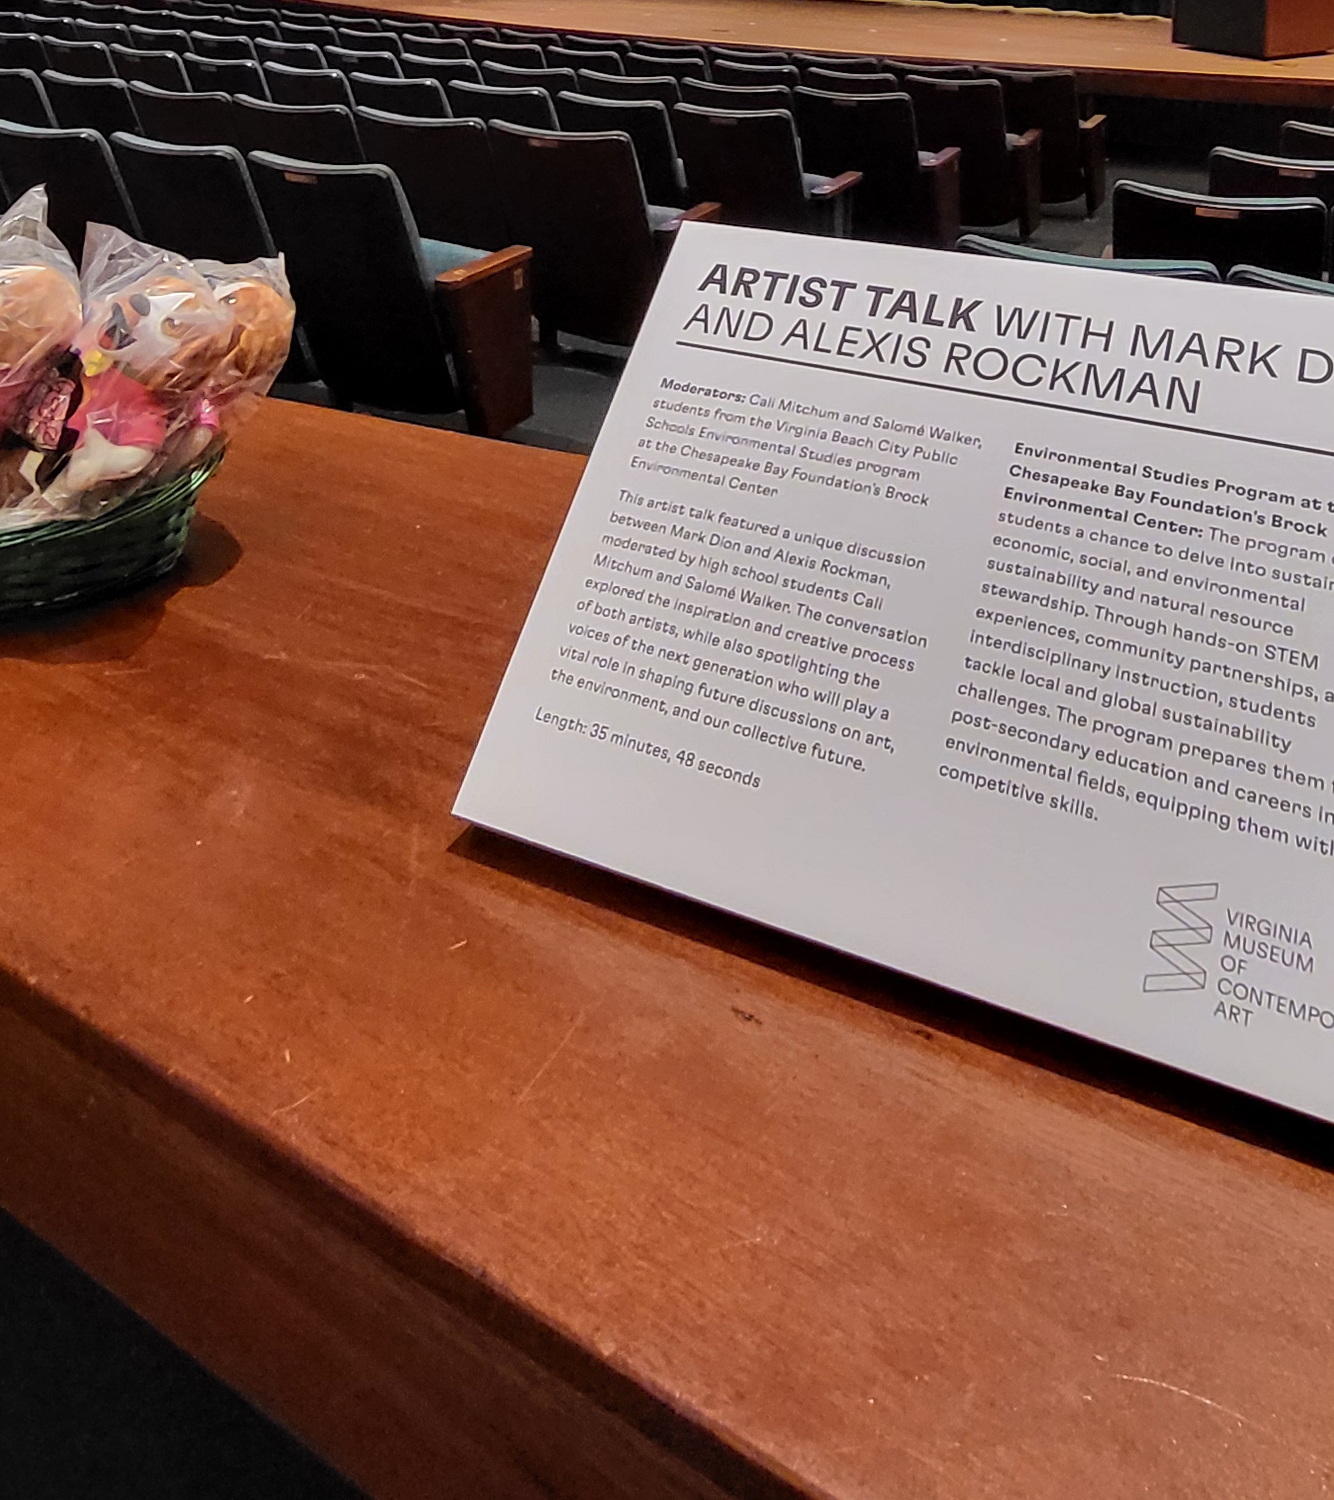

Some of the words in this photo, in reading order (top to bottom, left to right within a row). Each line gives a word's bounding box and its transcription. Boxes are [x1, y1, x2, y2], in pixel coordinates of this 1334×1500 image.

[682, 303, 774, 342] AND
[780, 318, 932, 369] ALEXIS
[943, 341, 1201, 414] ROCKMAN
[697, 263, 858, 312] ARTIST
[865, 284, 984, 333] TALK
[996, 304, 1115, 353] WITH
[1129, 324, 1283, 379] MARK
[1009, 464, 1110, 495] Chesapeake
[1114, 483, 1146, 505] Bay
[1271, 513, 1328, 538] Brock
[1014, 442, 1138, 477] Environmental
[1141, 465, 1210, 490] Studies
[1214, 478, 1295, 507] Program
[1300, 498, 1323, 511] at
[609, 510, 667, 535] between
[669, 524, 707, 544] Mark
[708, 533, 741, 552] Dion
[744, 544, 772, 559] and
[773, 548, 817, 570] Alexis
[820, 558, 891, 590] Rockman,
[619, 489, 645, 506] This
[646, 499, 686, 516] artist
[689, 507, 715, 522] talk
[717, 511, 781, 537] featured
[782, 529, 791, 540] a
[794, 532, 844, 551] unique
[846, 541, 926, 570] discussion
[997, 512, 1071, 536] students
[1075, 528, 1085, 539] a
[1089, 529, 1149, 552] chance
[1154, 542, 1173, 557] to
[1178, 546, 1225, 568] delve
[1230, 556, 1267, 577] into
[1003, 486, 1129, 523] Environmental
[1133, 512, 1204, 539] Center:
[1208, 526, 1241, 546] The
[1245, 537, 1326, 564] program
[593, 553, 654, 580] Mitchum
[655, 571, 684, 586] and
[684, 575, 737, 600] Salomé
[740, 588, 791, 614] Walker.
[796, 602, 822, 622] The
[825, 613, 928, 649] conversation
[601, 534, 677, 561] moderated
[678, 549, 697, 568] by
[698, 554, 729, 574] high
[731, 565, 780, 585] school
[781, 577, 849, 603] students
[853, 591, 884, 611] Cali
[986, 559, 1100, 596] sustainability
[1102, 584, 1136, 601] and
[1139, 593, 1205, 617] natural
[1209, 608, 1294, 637] resource
[992, 535, 1074, 564] economic,
[1078, 554, 1131, 577] social,
[1135, 566, 1169, 582] and
[1173, 574, 1305, 612] environmental
[576, 599, 594, 612] of
[593, 601, 626, 622] both
[628, 614, 679, 639] artists,
[683, 628, 721, 647] while
[723, 638, 753, 656] also
[755, 648, 850, 685] spotlighting
[853, 672, 880, 690] the
[585, 578, 646, 602] explored
[647, 592, 671, 608] the
[673, 598, 751, 629] inspiration
[754, 621, 783, 637] and
[785, 630, 849, 655] creative
[851, 646, 915, 672] process
[975, 607, 1080, 645] experiences,
[1084, 633, 1186, 670] community
[1189, 658, 1319, 703] partnerships,
[981, 583, 1089, 618] stewardship.
[1094, 604, 1167, 636] Through
[1172, 622, 1258, 657] hands-on
[1264, 644, 1319, 671] STEM
[560, 646, 591, 663] vital
[591, 656, 620, 672] role
[622, 661, 636, 676] in
[638, 667, 695, 696] shaping
[697, 682, 746, 708] future
[748, 698, 838, 734] discussions
[841, 726, 861, 741] on
[865, 733, 895, 754] art,
[569, 623, 611, 643] voices
[612, 634, 631, 648] of
[630, 638, 655, 655] the
[657, 648, 690, 666] next
[691, 657, 774, 689] generation
[778, 680, 810, 698] who
[813, 690, 841, 707] will
[842, 697, 878, 720] play
[880, 708, 890, 721] a
[964, 656, 1016, 680] tackle
[1019, 668, 1061, 692] local
[1064, 683, 1098, 702] and
[1101, 691, 1158, 717] global
[1162, 708, 1292, 754] sustainability
[969, 628, 1112, 680] interdisciplinary
[1115, 664, 1223, 708] instruction,
[1228, 696, 1316, 728] students
[535, 706, 588, 735] Length:
[589, 723, 610, 741] 35
[609, 733, 671, 764] minutes,
[675, 749, 696, 767] 48
[697, 759, 761, 788] seconds
[551, 668, 574, 686] the
[576, 677, 669, 716] environment,
[672, 705, 701, 722] and
[703, 714, 730, 730] our
[732, 723, 807, 754] collective
[811, 742, 866, 772] future.
[957, 681, 1051, 719] challenges.
[1056, 704, 1088, 727] The
[1091, 719, 1173, 751] program
[1178, 742, 1267, 775] prepares
[1272, 764, 1325, 791] them
[939, 765, 1045, 805] competitive
[1049, 794, 1098, 822] skills.
[945, 737, 1073, 783] environmental
[1077, 770, 1130, 802] fields,
[1135, 790, 1231, 831] equipping
[1236, 816, 1289, 844] them
[950, 710, 1091, 761] post-secondary
[1095, 749, 1188, 785] education
[1193, 776, 1230, 796] and
[1234, 787, 1312, 819] careers
[1220, 954, 1248, 975] OF
[1223, 930, 1314, 974] MUSEUM
[1226, 907, 1313, 950] VIRGINIA
[1213, 1000, 1254, 1027] ART
